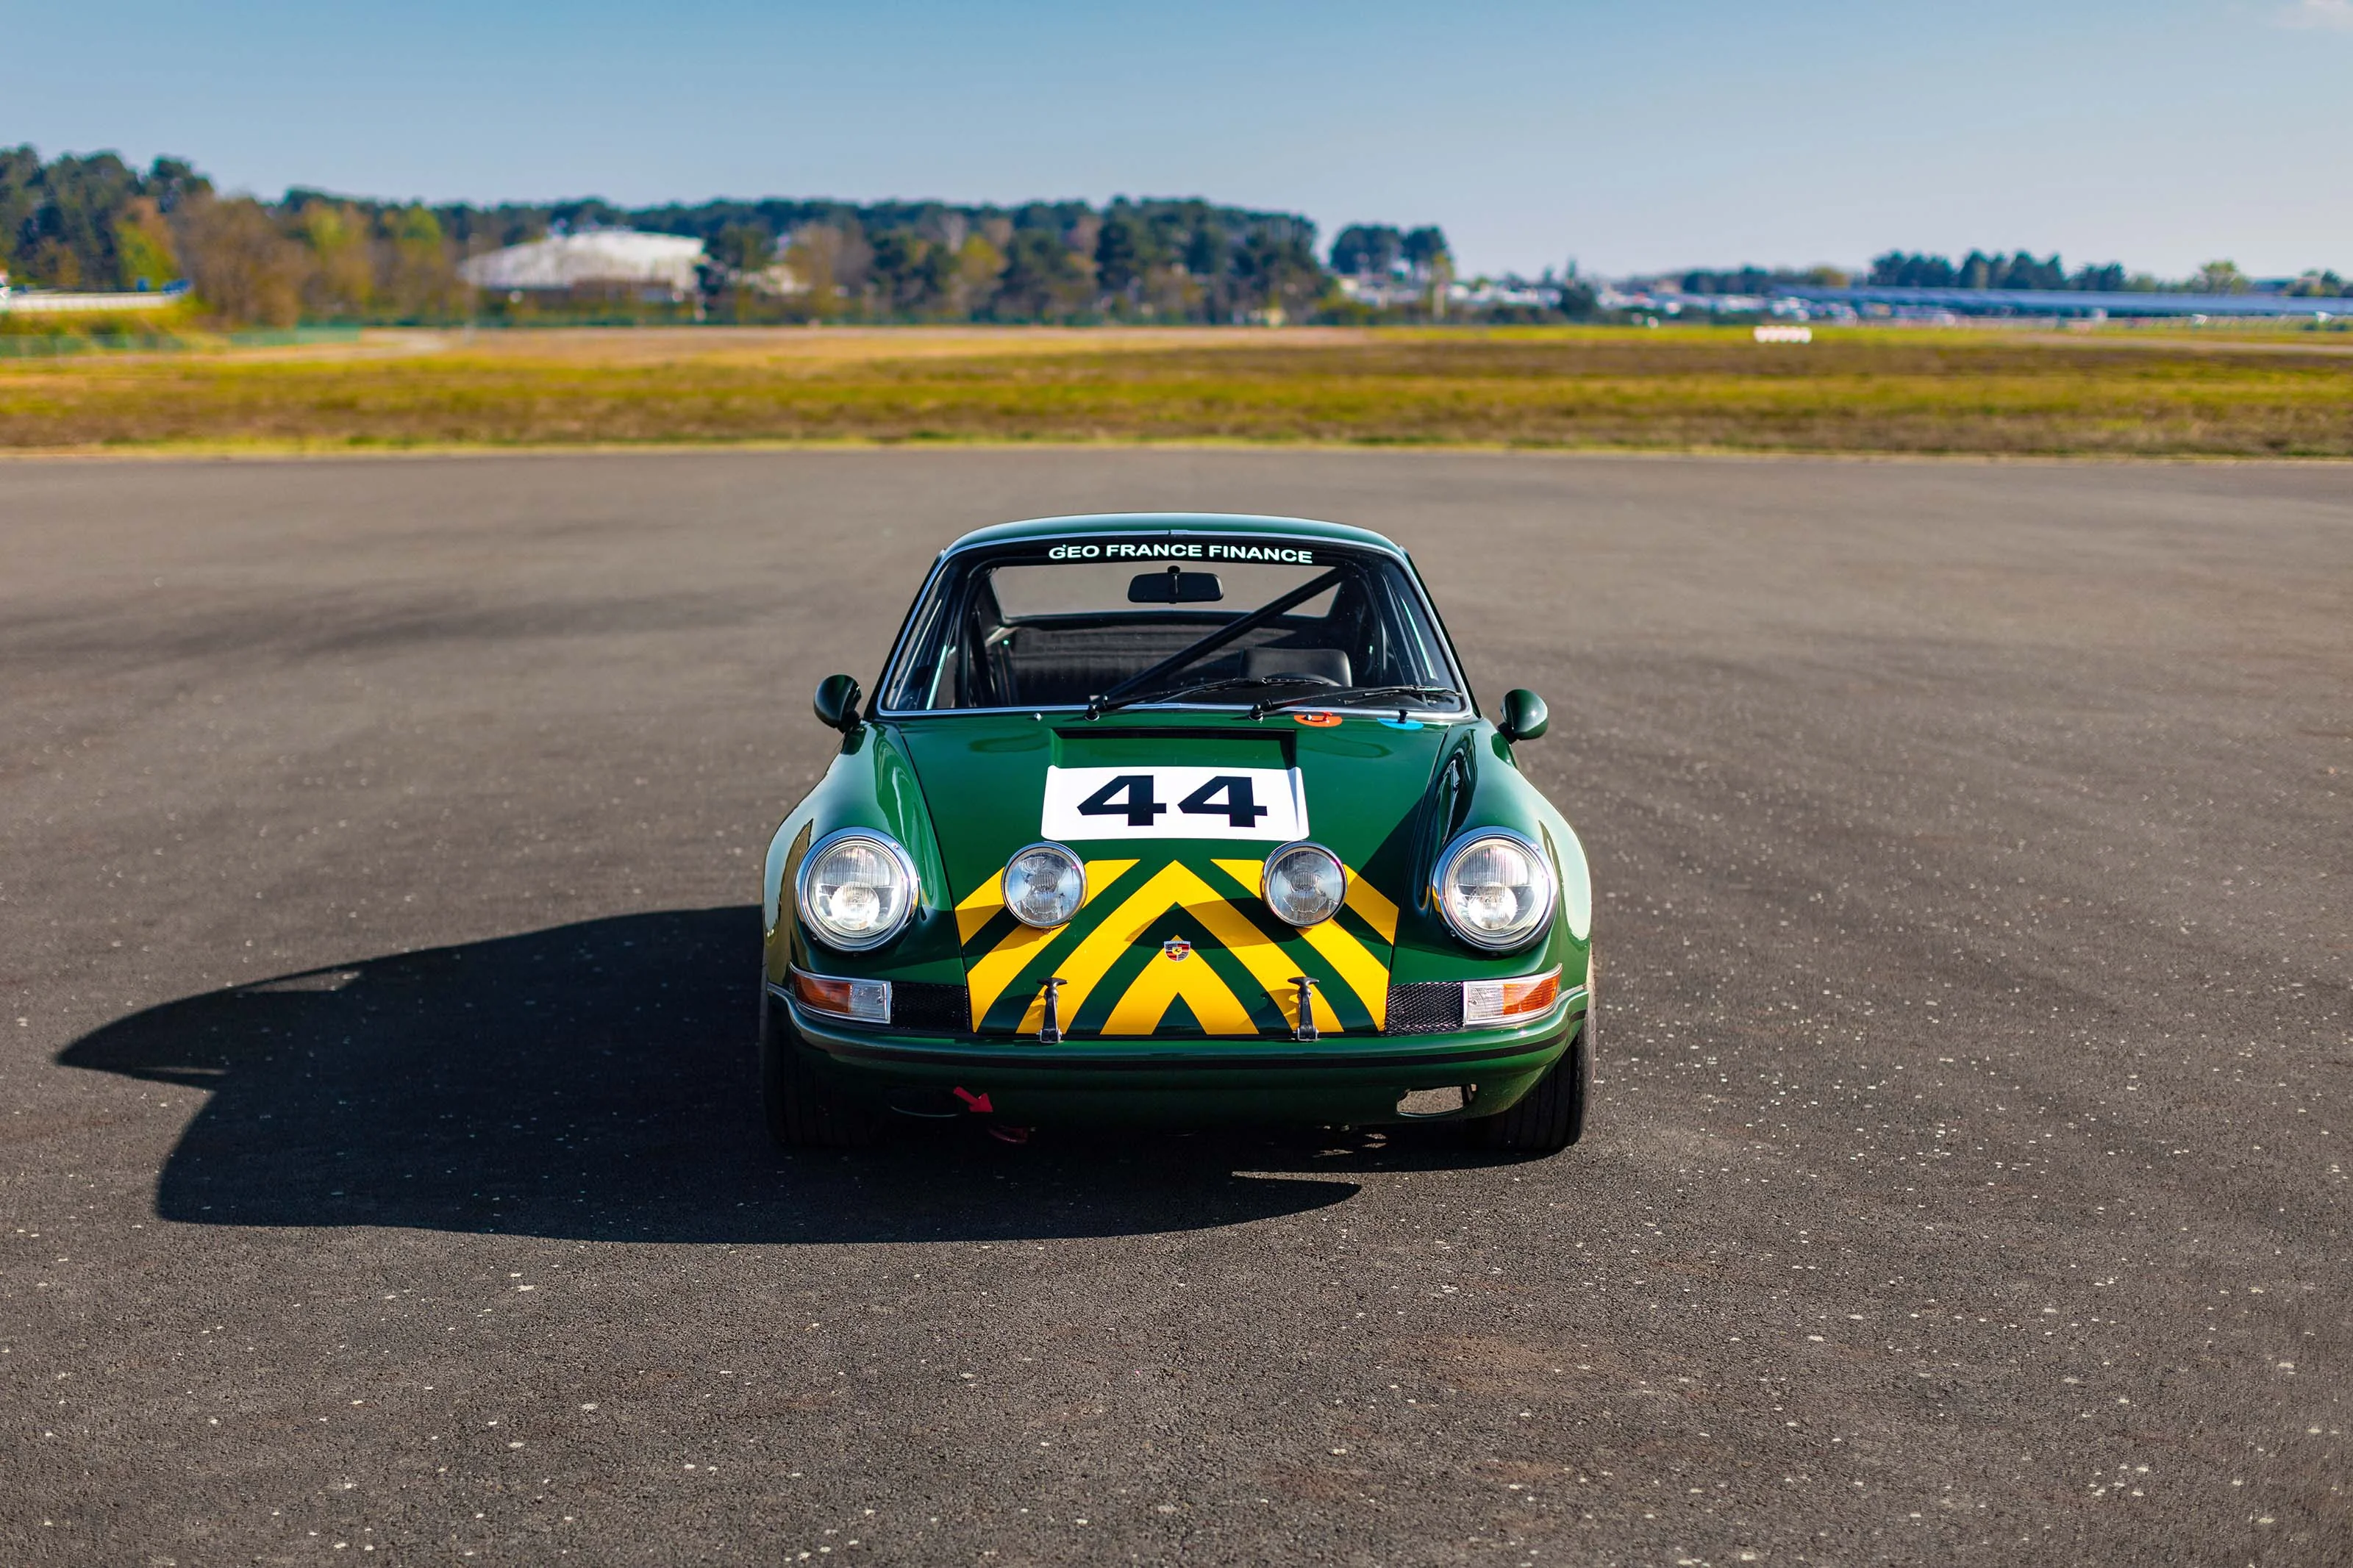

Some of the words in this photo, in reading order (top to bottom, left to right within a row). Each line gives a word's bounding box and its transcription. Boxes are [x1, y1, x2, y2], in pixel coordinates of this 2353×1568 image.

[1049, 545, 1100, 559] GEO
[1106, 544, 1203, 557] FRANCE
[1209, 545, 1313, 564] FINANCE
[1076, 775, 1268, 828] 44
